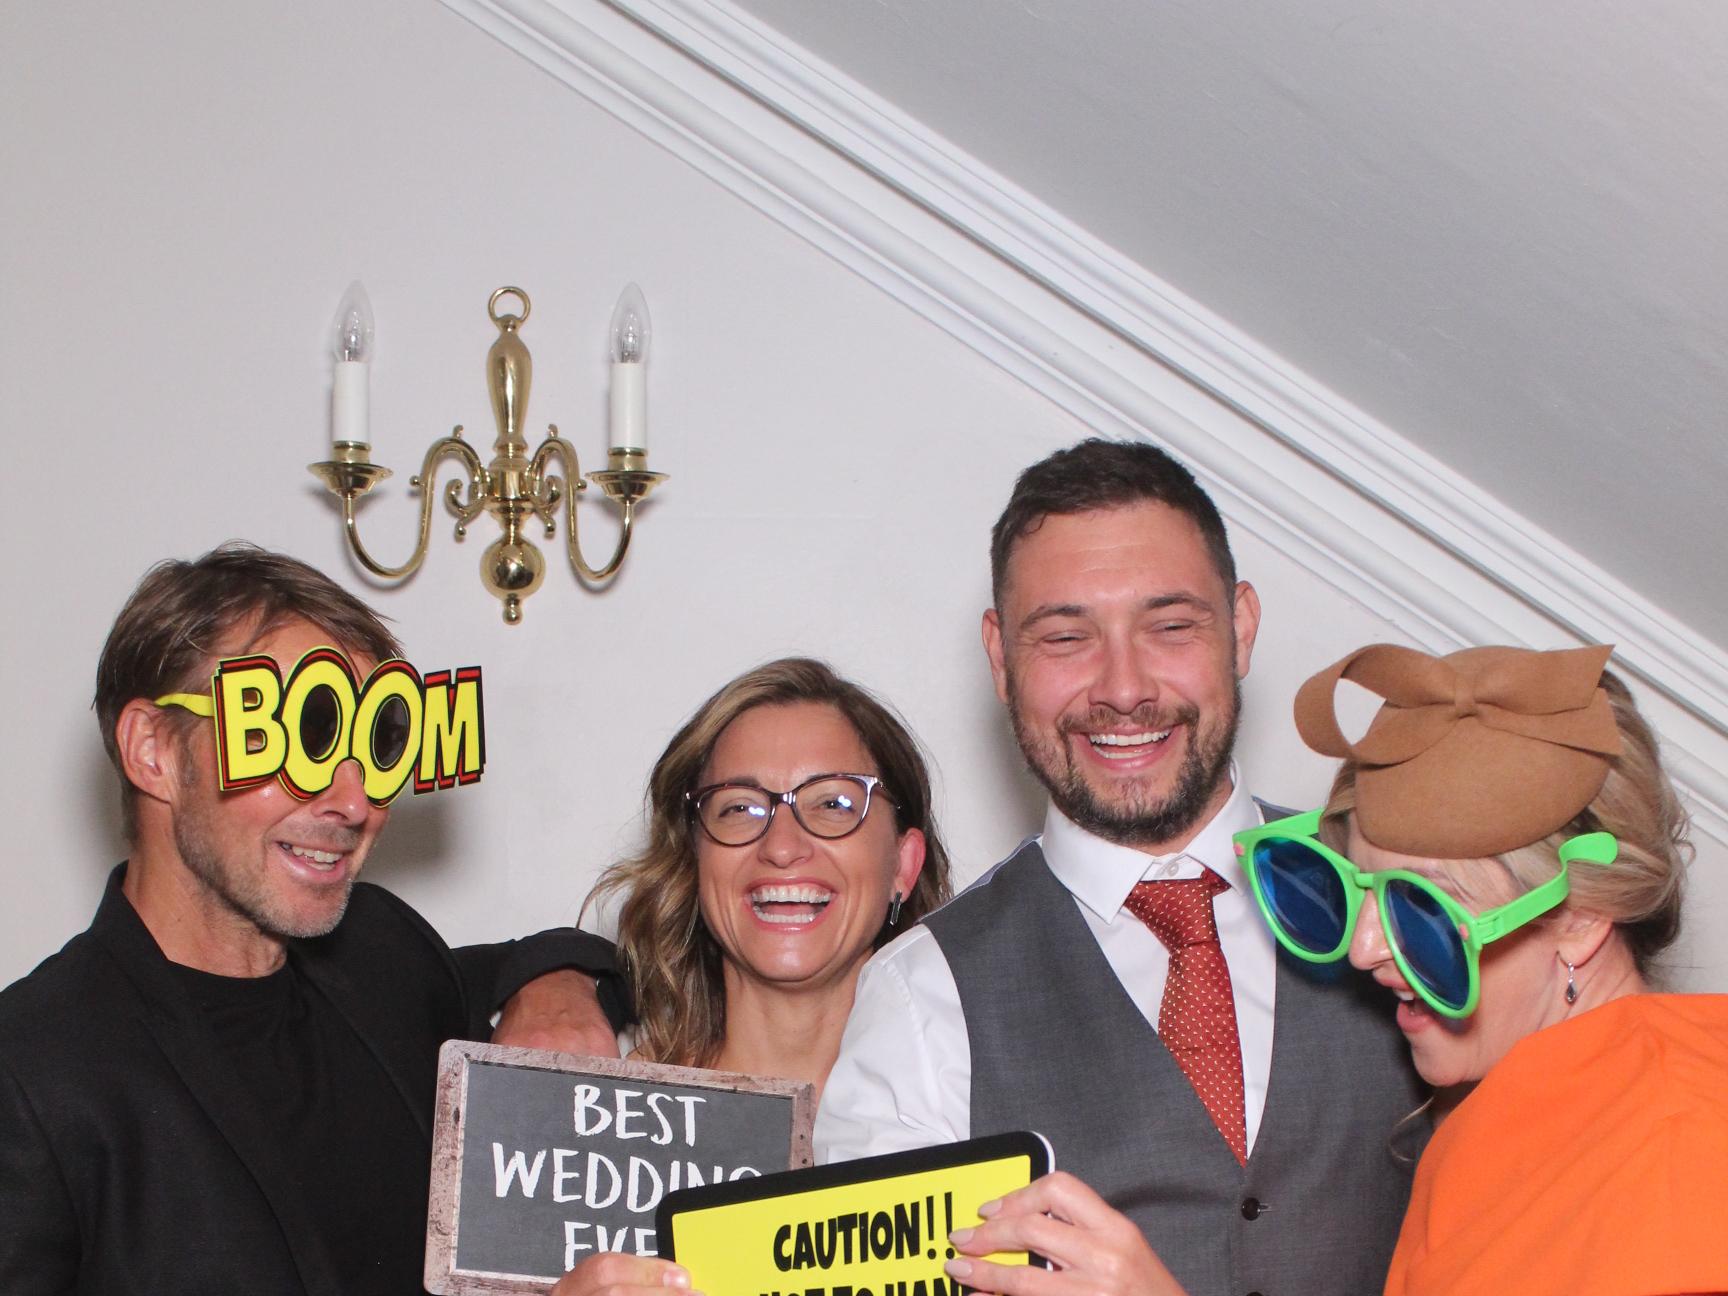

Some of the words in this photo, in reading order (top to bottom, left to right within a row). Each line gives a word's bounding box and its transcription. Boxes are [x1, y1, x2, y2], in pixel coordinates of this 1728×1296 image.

[213, 648, 485, 807] BOOM
[574, 1084, 706, 1147] BEST
[492, 1142, 763, 1213] WEDDI
[564, 1221, 657, 1272] EVE
[773, 1191, 956, 1273] CAUTION!!
